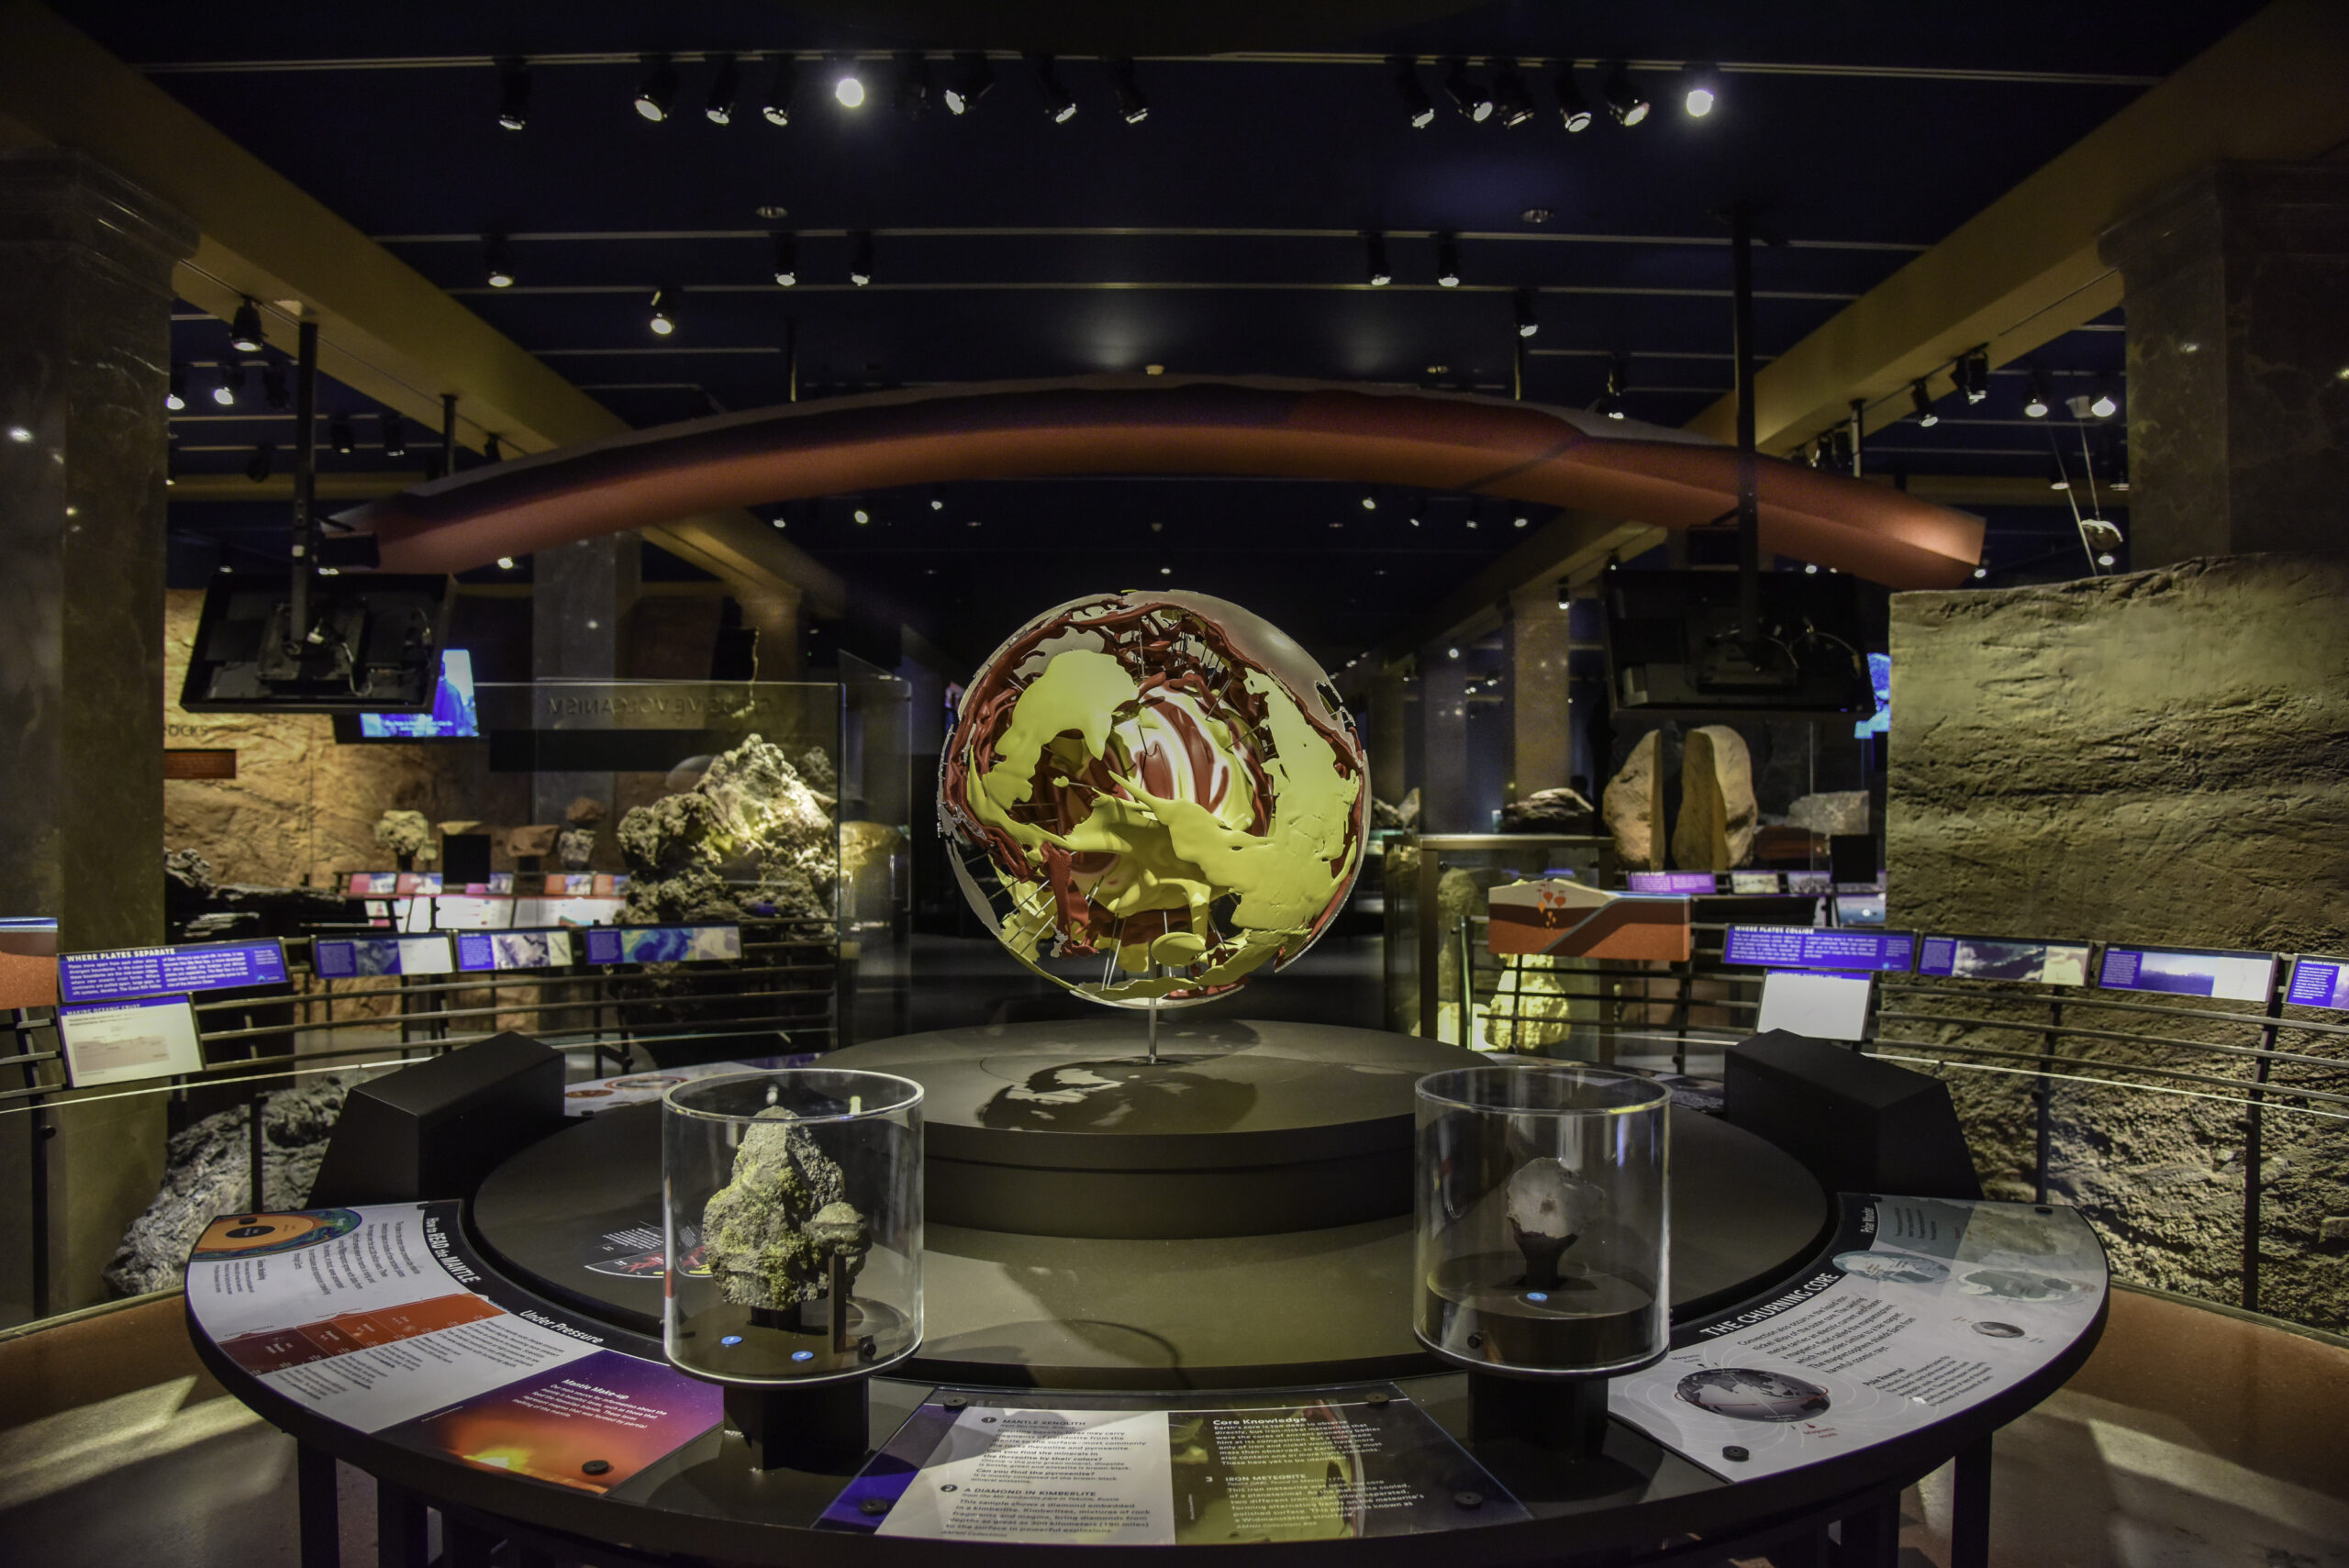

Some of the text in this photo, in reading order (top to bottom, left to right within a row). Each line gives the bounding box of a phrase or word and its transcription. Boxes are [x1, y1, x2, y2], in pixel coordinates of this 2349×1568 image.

[66, 953, 98, 962] WHERE
[134, 948, 176, 957] SEPARATE
[428, 1233, 450, 1249] READ
[435, 1248, 448, 1258] the
[440, 1256, 481, 1283] MANTLE
[1699, 1273, 1839, 1336] THE CHURNING CORE
[519, 1309, 604, 1344] Under Pressure
[562, 1379, 629, 1400] Mantle Make-up
